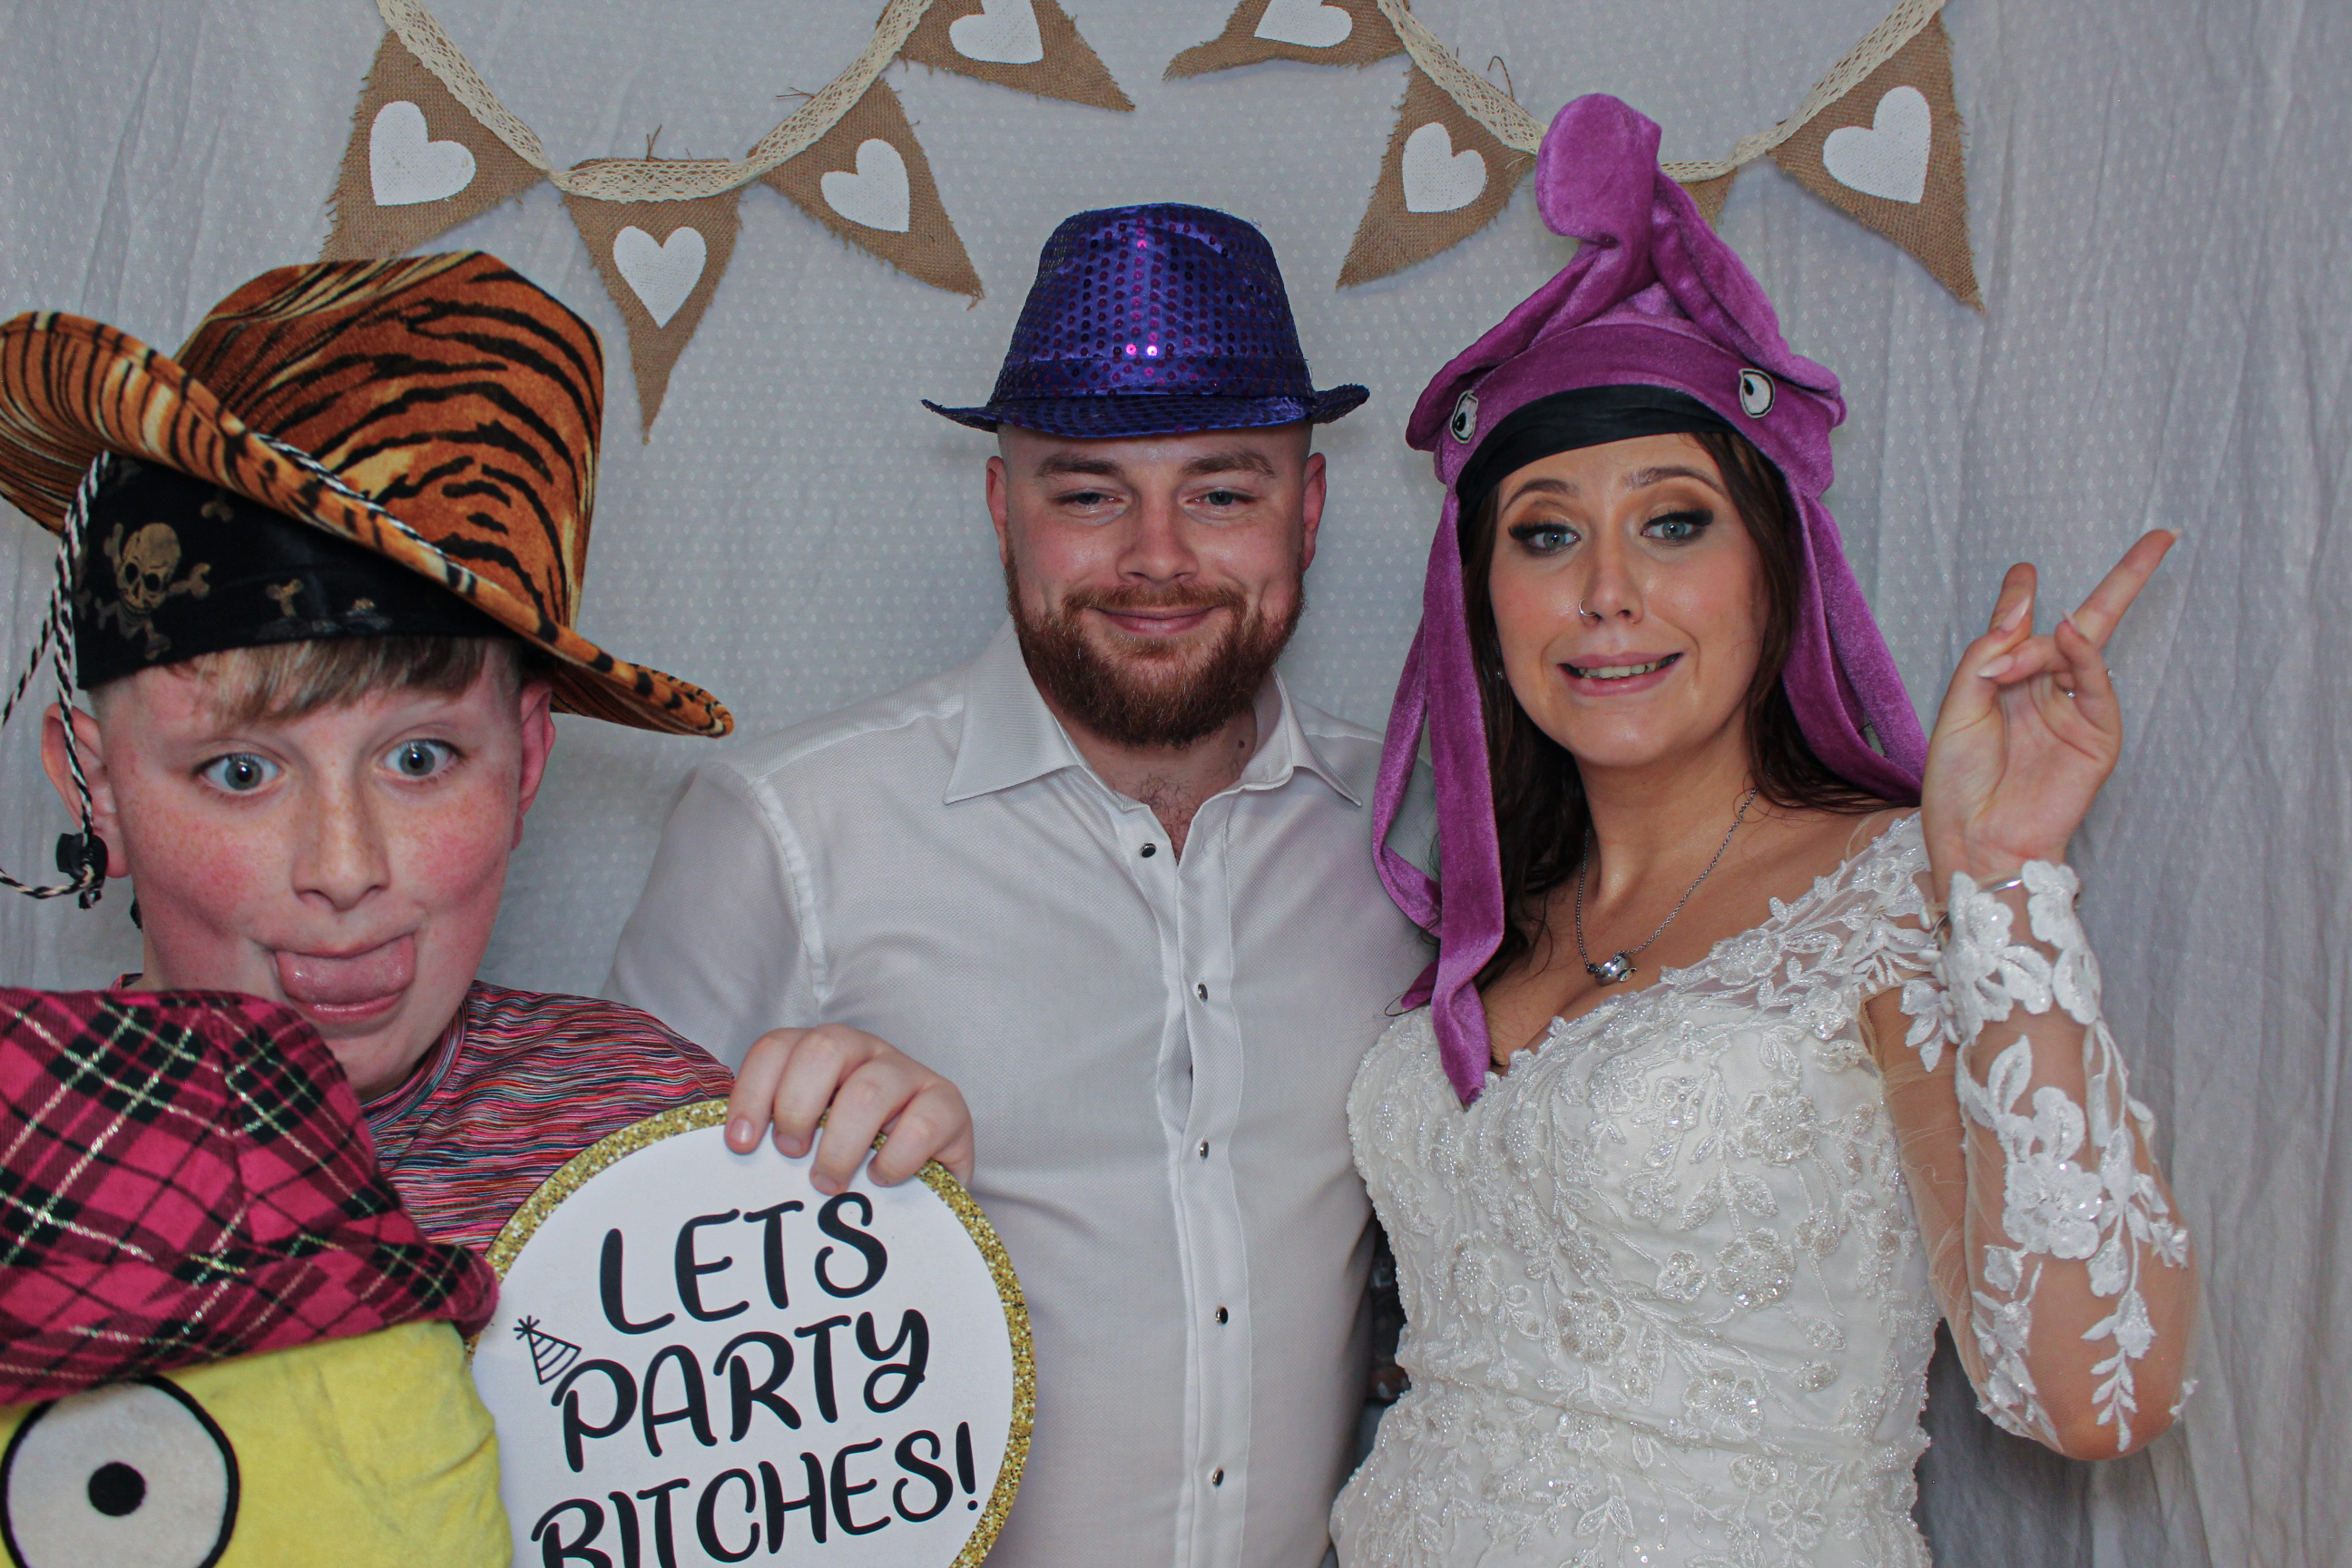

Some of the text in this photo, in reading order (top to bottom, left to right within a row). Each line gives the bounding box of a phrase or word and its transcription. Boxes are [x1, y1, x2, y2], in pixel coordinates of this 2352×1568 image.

[599, 1191, 887, 1335] LETS
[551, 1308, 929, 1473] PARTY
[531, 1421, 978, 1568] BITCHES!
